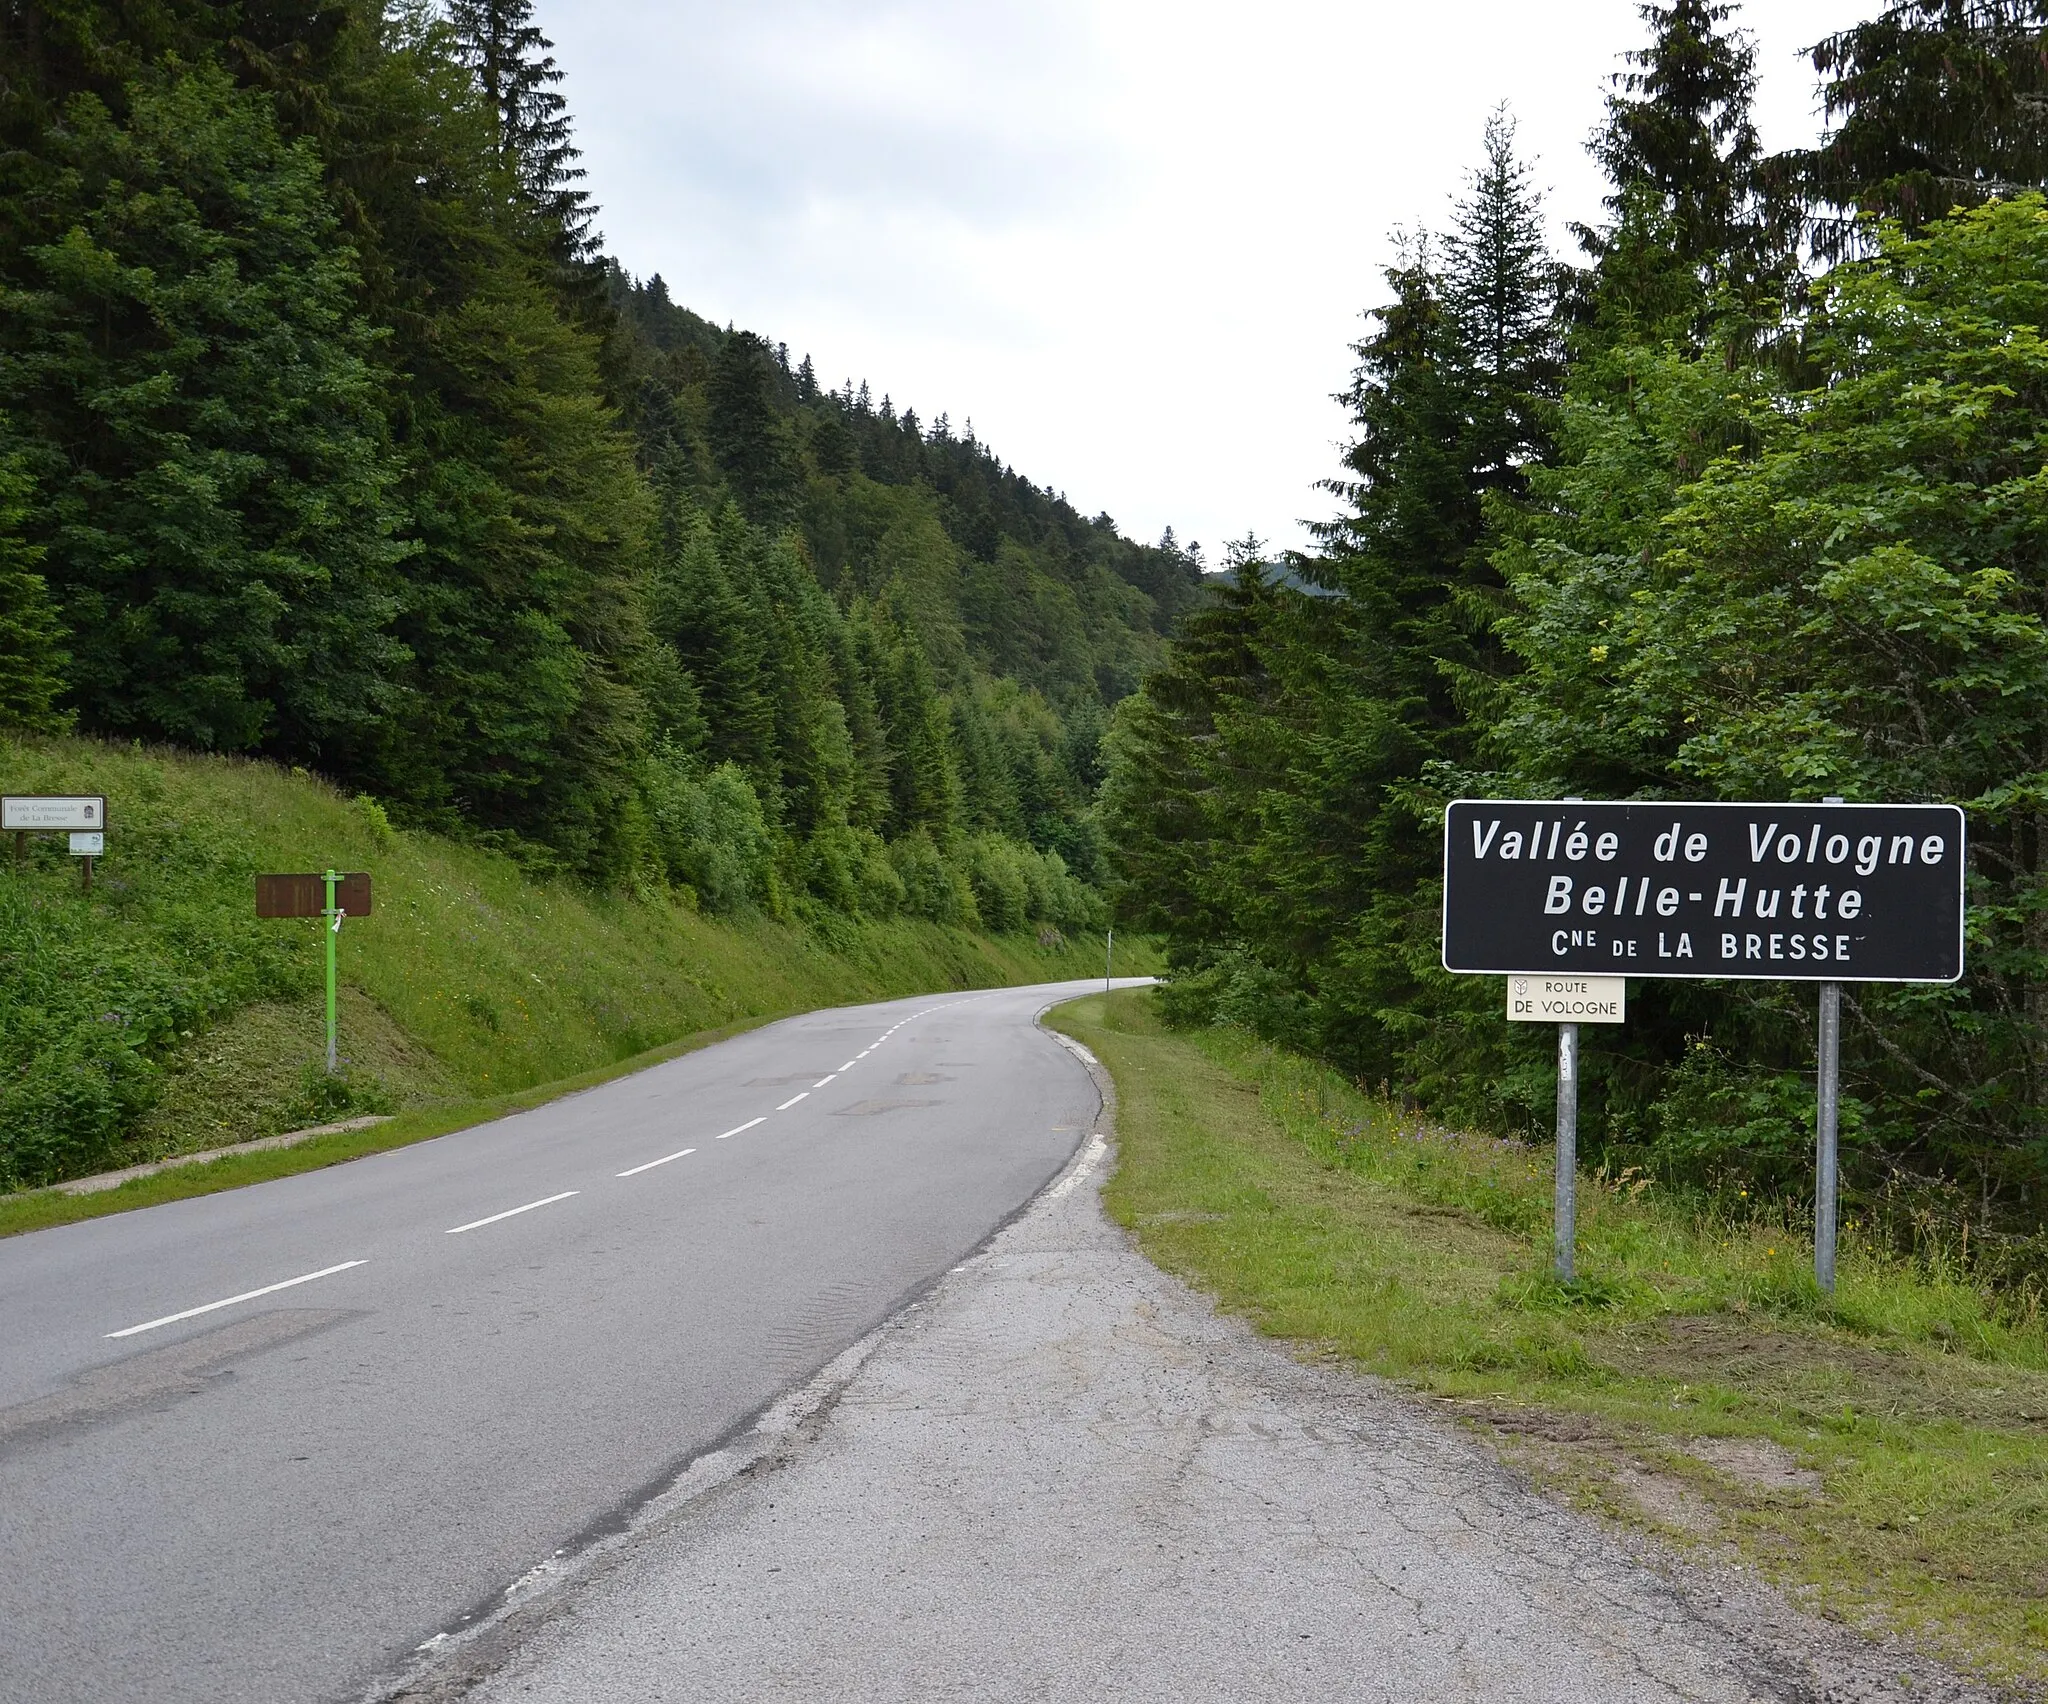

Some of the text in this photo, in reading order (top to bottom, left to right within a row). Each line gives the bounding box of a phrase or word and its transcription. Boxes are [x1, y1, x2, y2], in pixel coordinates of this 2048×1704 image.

[1472, 820, 1945, 876] Vallée de Vologne
[1543, 875, 1862, 920] Belle-Hutte
[1612, 940, 1638, 957] DE
[1658, 932, 1693, 958] LA
[1721, 933, 1851, 961] BRESSE
[1545, 982, 1588, 993] ROUTE
[1514, 1000, 1618, 1015] DE VOLOGNE
